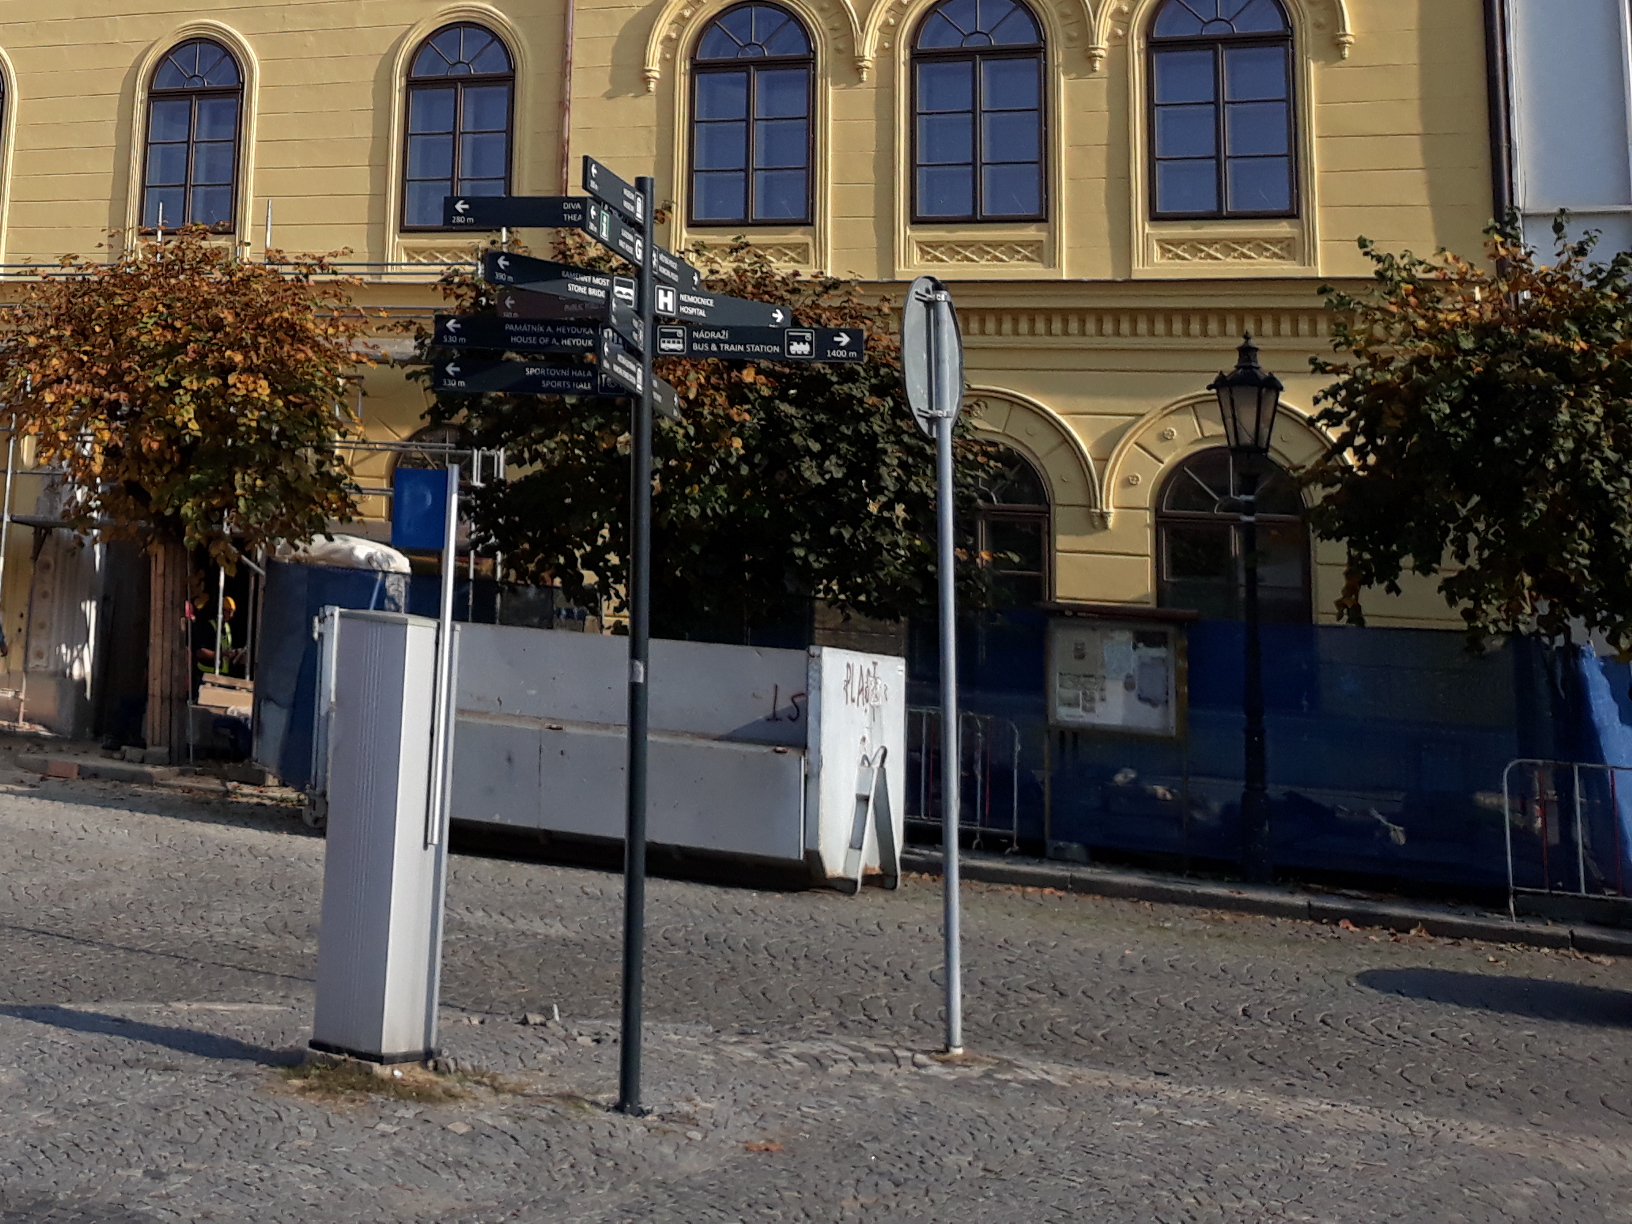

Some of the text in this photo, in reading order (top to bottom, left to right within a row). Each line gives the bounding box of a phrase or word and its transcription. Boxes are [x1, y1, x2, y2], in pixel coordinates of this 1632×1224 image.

[562, 202, 582, 211] DIVA
[451, 215, 466, 224] 280
[563, 213, 582, 222] THEA
[592, 276, 610, 287] MOST
[567, 282, 588, 295] STONE
[679, 293, 715, 307] NEMOCNICE
[679, 305, 707, 318] HOSPITAL
[504, 323, 545, 333] PAMÁTNÍK
[692, 329, 729, 340] NÁDRAŽÍ
[458, 336, 467, 344] m
[510, 335, 537, 344] HOUSE
[538, 336, 549, 345] OF
[692, 342, 781, 354] BUS & TRAIN STATION
[826, 349, 858, 358] 1400 m
[525, 367, 593, 378] SPORTOVNÍ HALA
[457, 380, 466, 388] m
[541, 379, 571, 389] SPORTS
